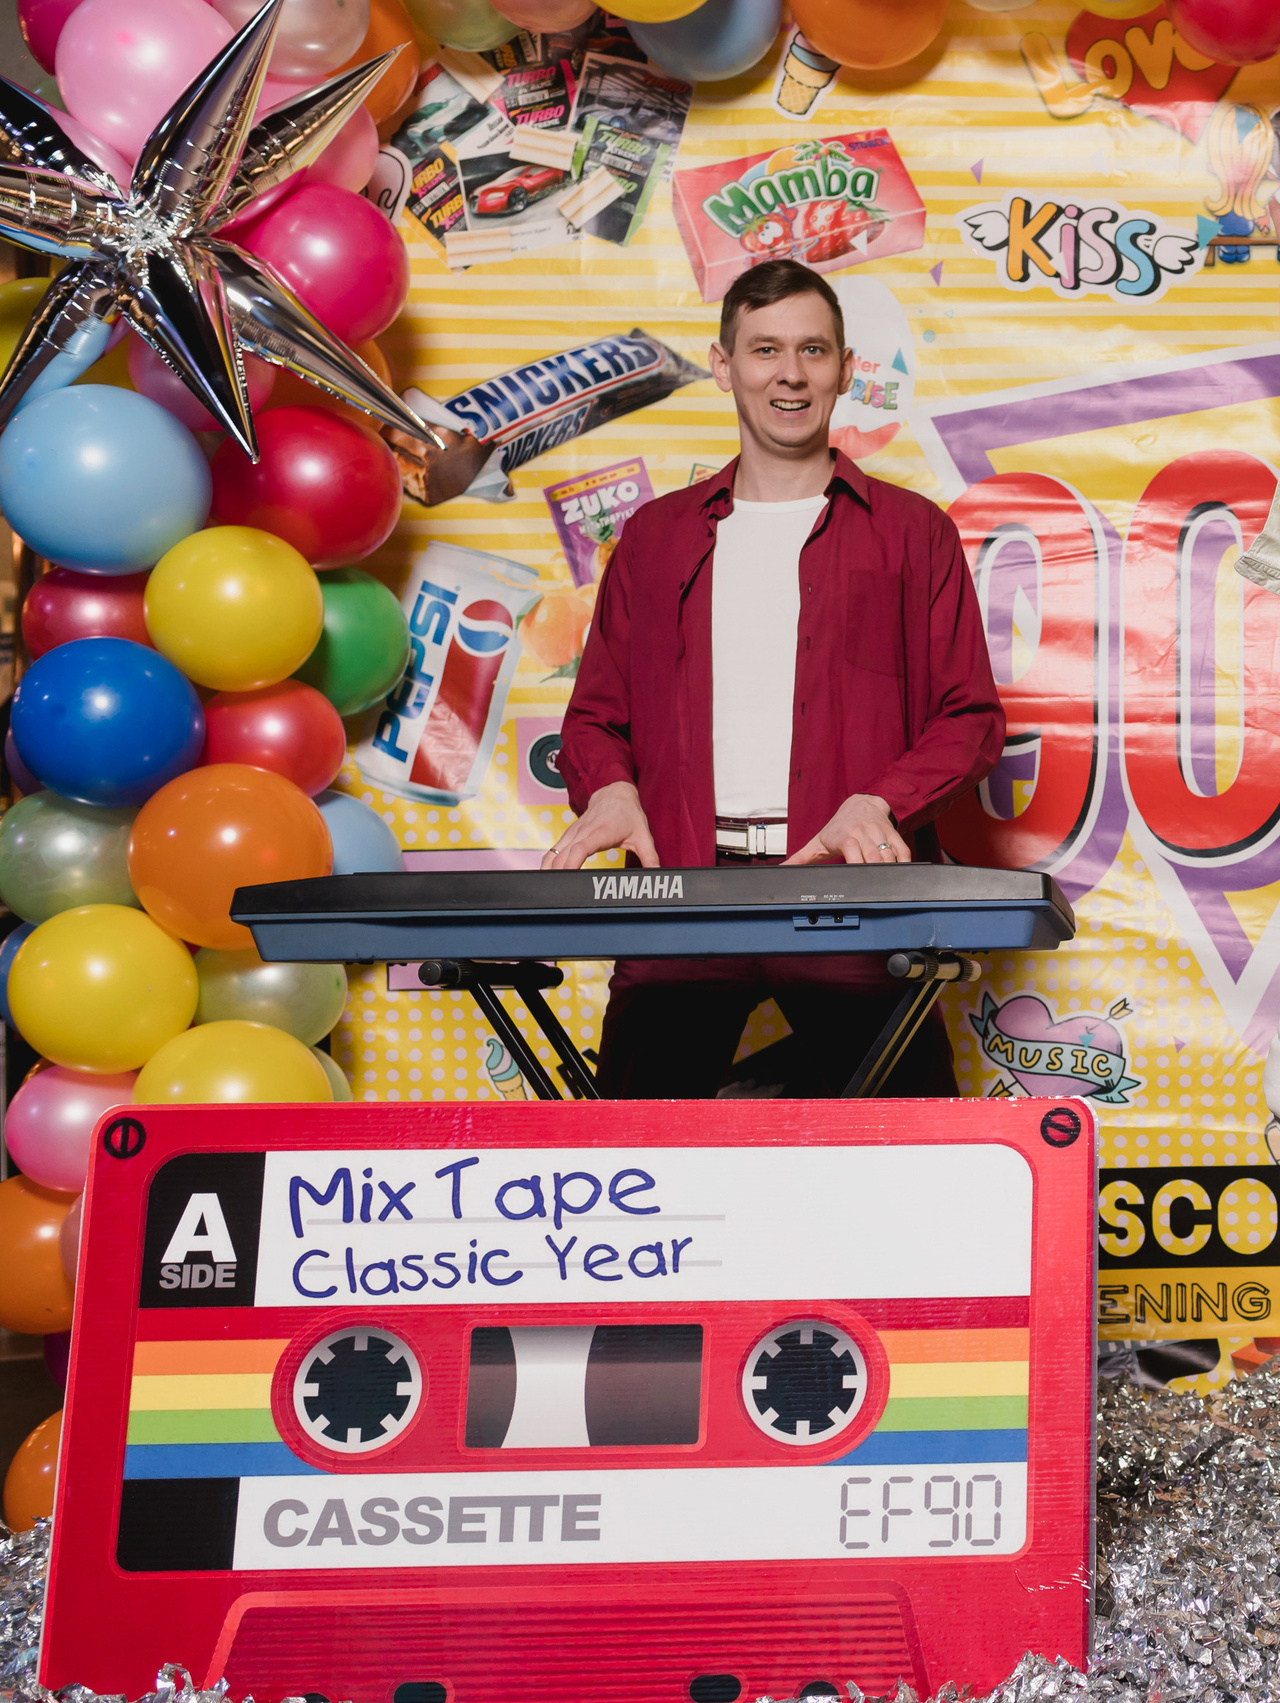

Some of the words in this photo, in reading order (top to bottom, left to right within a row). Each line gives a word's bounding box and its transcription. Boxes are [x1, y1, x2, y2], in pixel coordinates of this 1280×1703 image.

[507, 66, 557, 88] TURBO
[516, 105, 565, 126] TURBO
[599, 131, 651, 157] TURBO
[848, 137, 891, 152] STORCK
[411, 157, 445, 193] URBO
[702, 155, 879, 239] Mamba
[429, 194, 464, 229] TURB
[445, 336, 660, 439] SNICKERS
[850, 378, 899, 410] RISE
[560, 480, 641, 526] ZUKO
[371, 579, 462, 765] PEPSI
[592, 875, 684, 900] YAMAHA
[989, 1034, 1113, 1079] MUSIC
[288, 1167, 417, 1238] Mix
[434, 1156, 662, 1229] Tape
[1098, 1177, 1279, 1258] SCO
[160, 1192, 238, 1264] A
[159, 1262, 236, 1290] SIDE
[292, 1239, 524, 1299] Classic
[545, 1234, 693, 1283] Year
[1098, 1281, 1273, 1323] ENING
[263, 1493, 602, 1548] CASSETTE
[839, 1473, 1003, 1550] EF90
